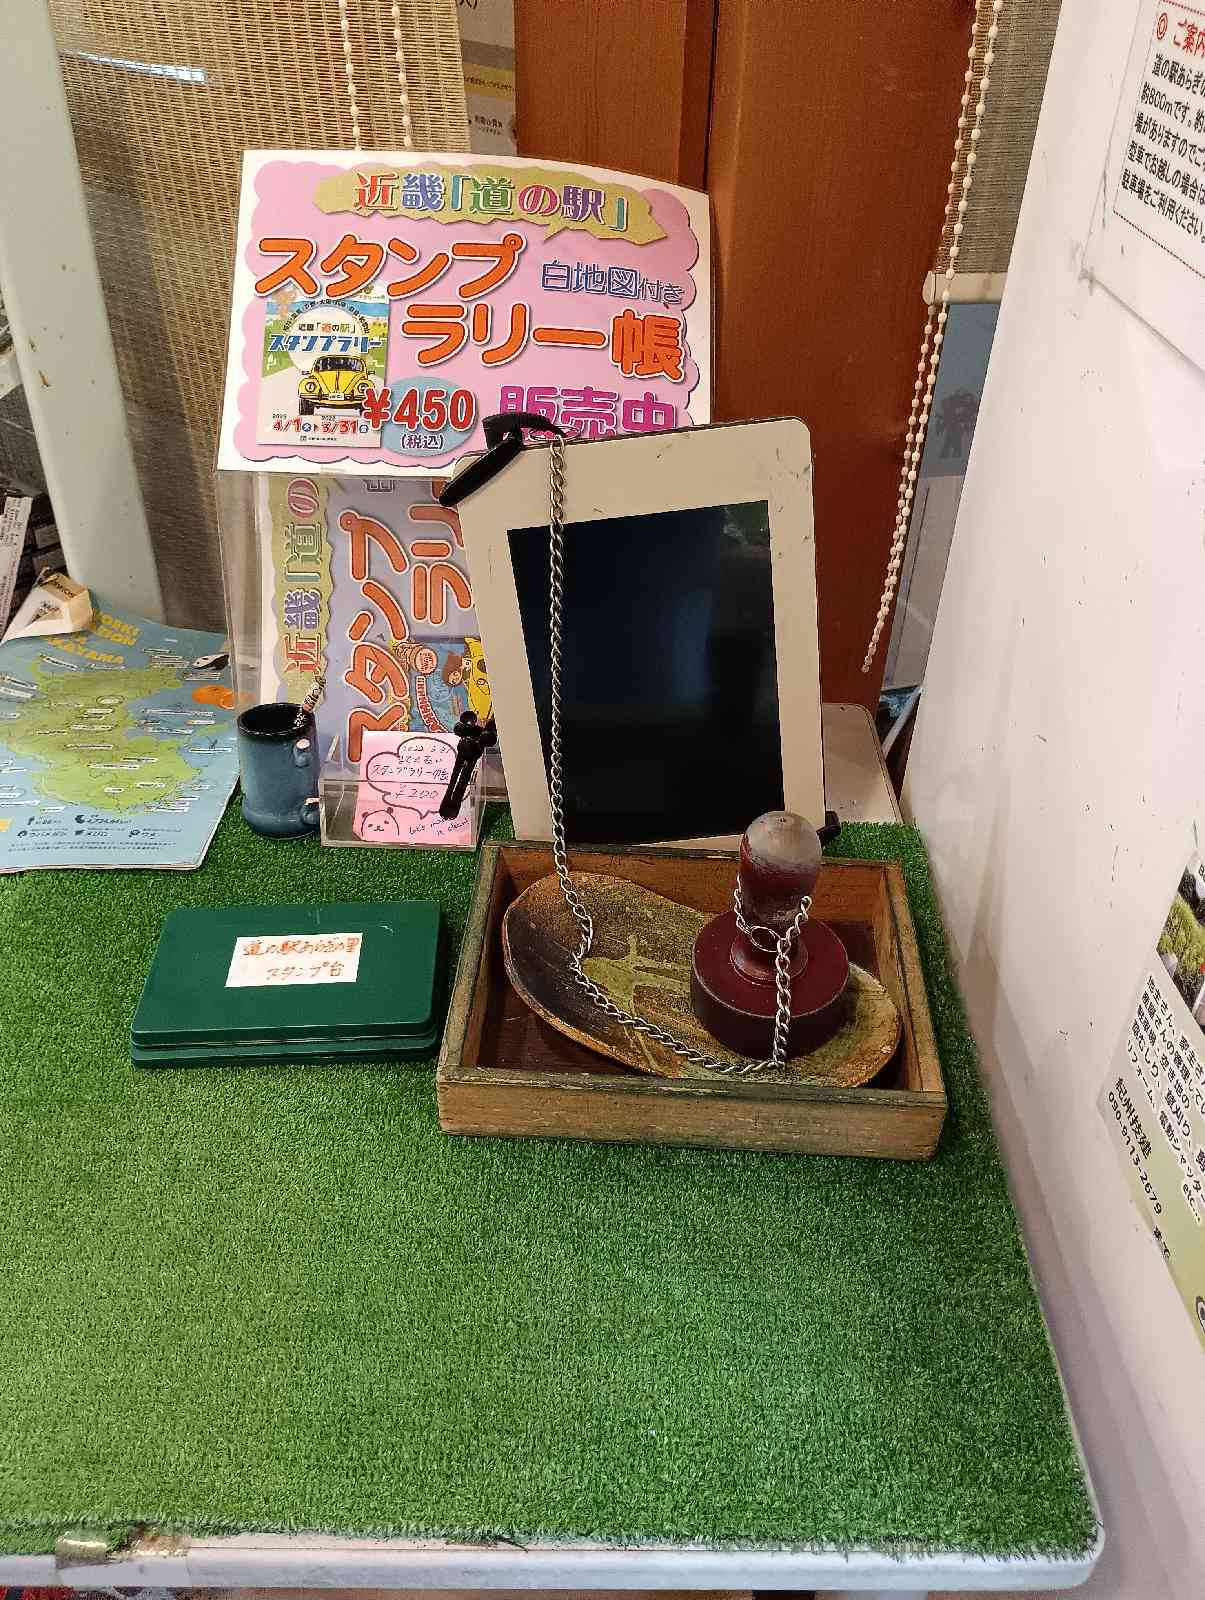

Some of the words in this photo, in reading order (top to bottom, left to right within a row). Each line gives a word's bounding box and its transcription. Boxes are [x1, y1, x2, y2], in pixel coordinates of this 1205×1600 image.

[354, 172, 627, 231] 近畿「道の駅」
[255, 234, 524, 298] スタンプ
[542, 260, 684, 305] 白地図付き
[269, 335, 383, 353] スタンプラリー
[402, 303, 682, 381] ラリー帳
[401, 433, 444, 450] (税込)
[409, 478, 472, 625] ラリ
[339, 511, 410, 763] スタンプ
